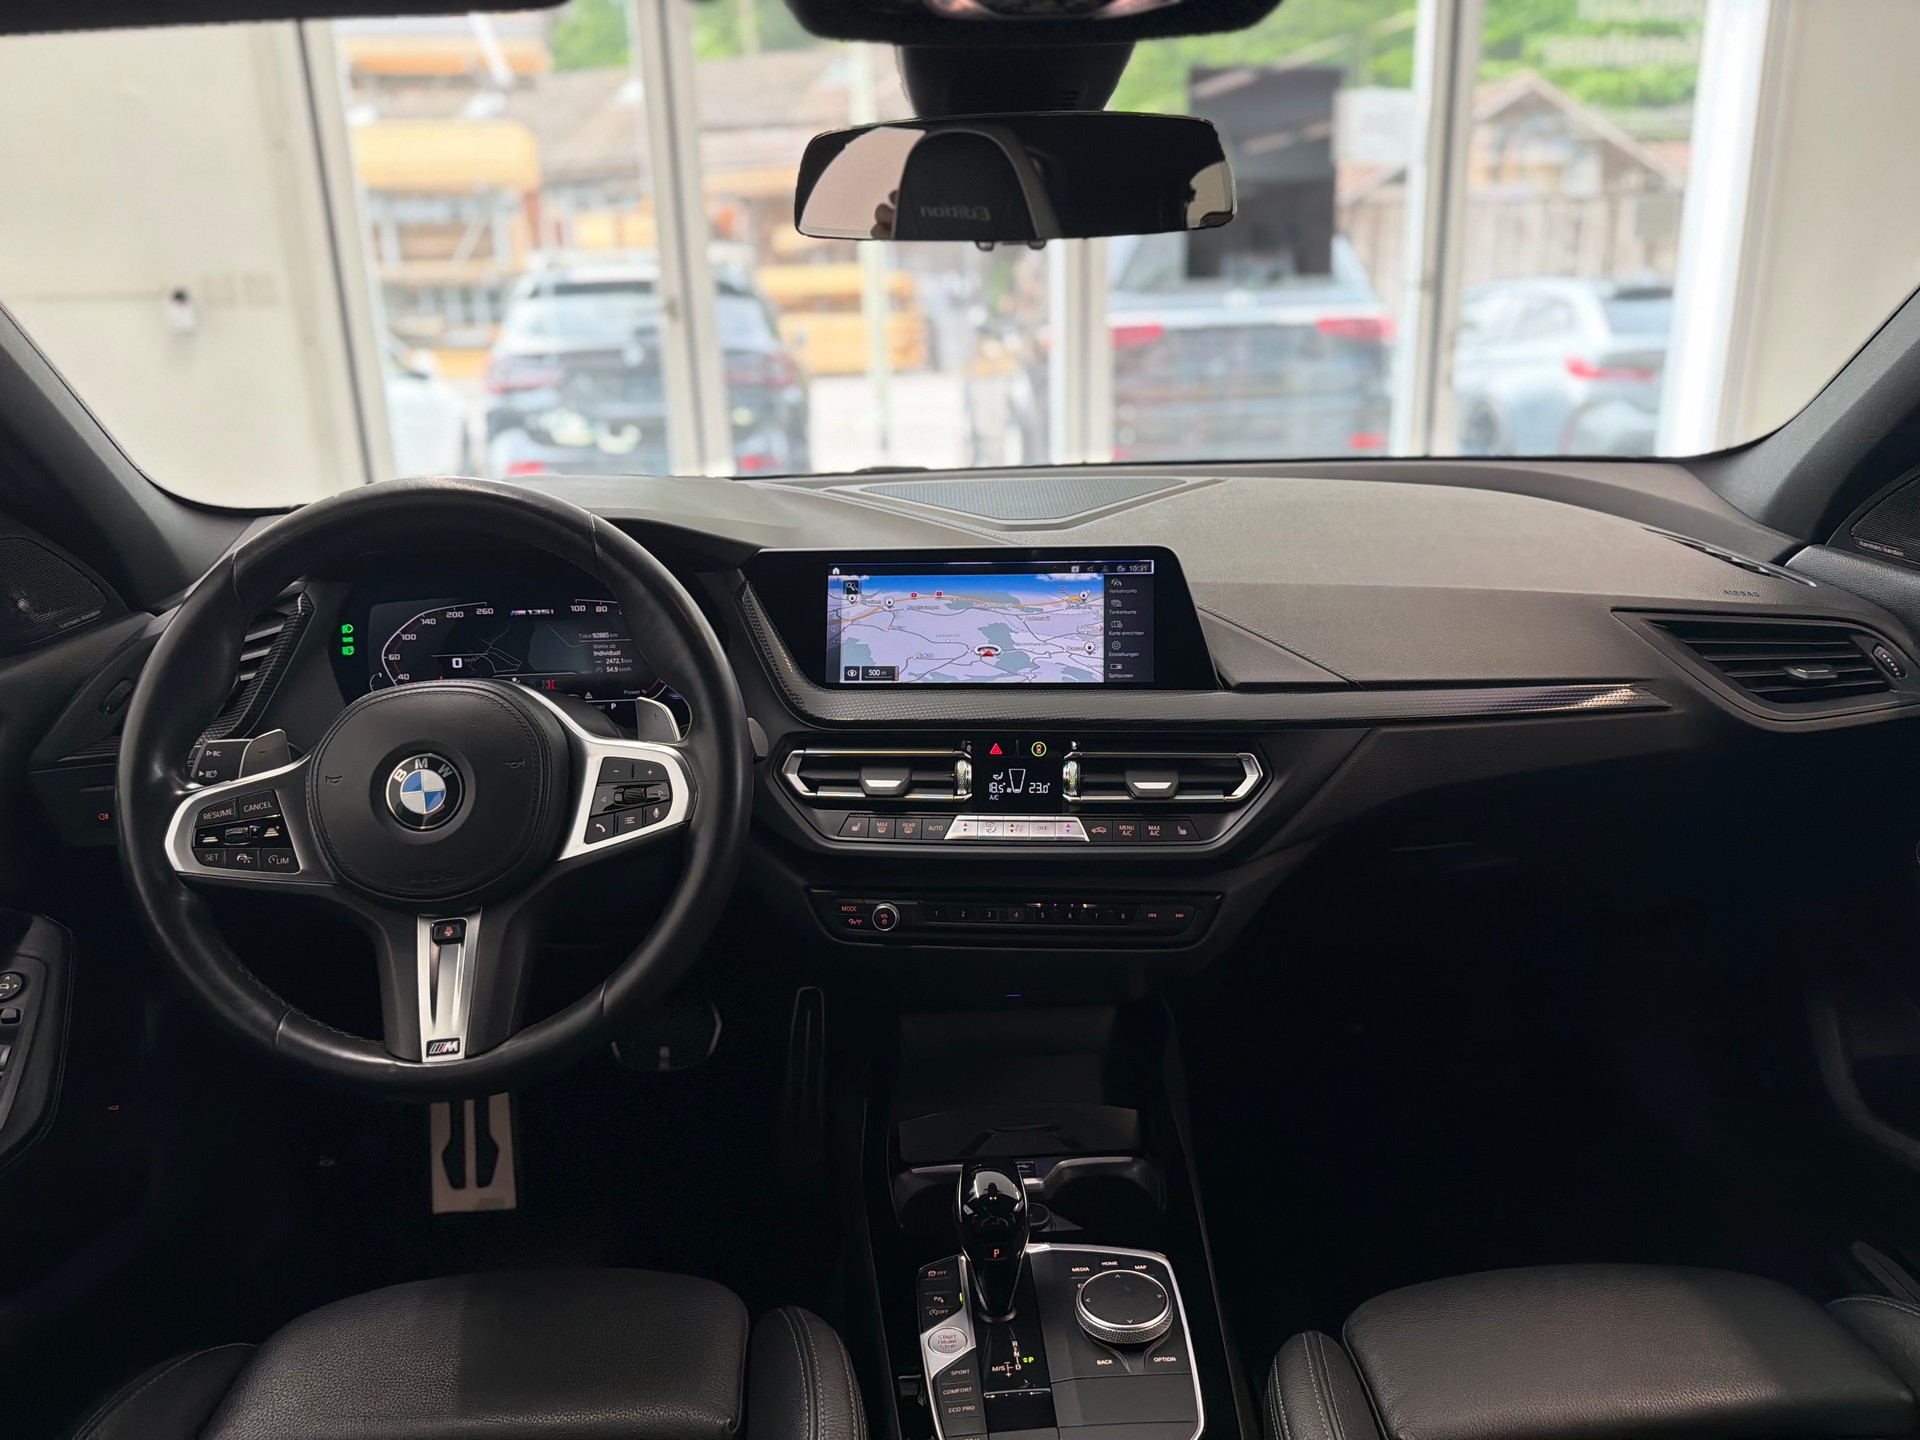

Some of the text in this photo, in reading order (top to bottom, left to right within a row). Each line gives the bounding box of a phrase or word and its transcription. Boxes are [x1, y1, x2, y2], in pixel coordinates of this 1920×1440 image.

[1724, 590, 1760, 598] AIRBAG
[446, 611, 464, 619] 200
[398, 673, 410, 681] 40
[394, 758, 453, 782] BMW
[243, 801, 273, 812] CANCEL
[203, 808, 234, 820] RESUME
[204, 853, 219, 861] SET
[993, 1249, 1000, 1258] P
[942, 1387, 972, 1395] COMFORT
